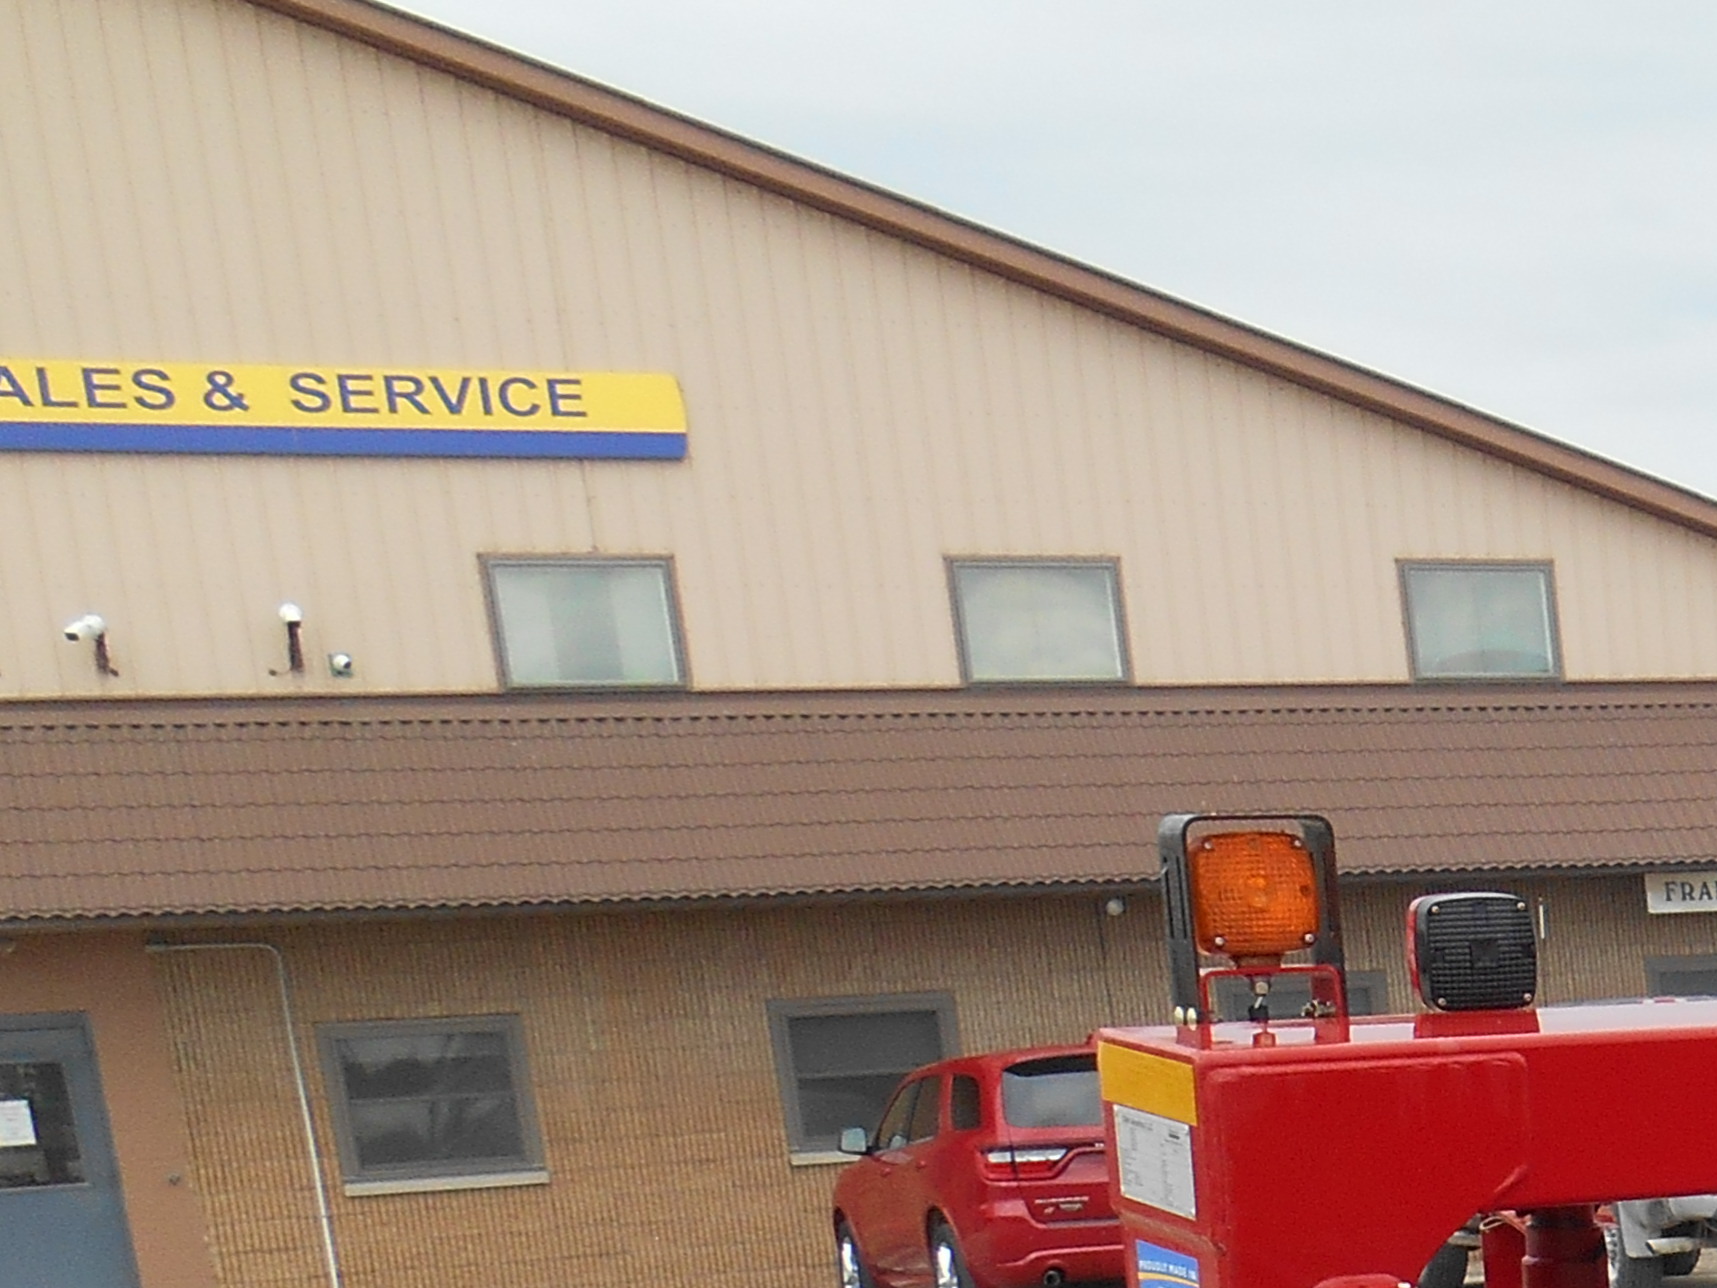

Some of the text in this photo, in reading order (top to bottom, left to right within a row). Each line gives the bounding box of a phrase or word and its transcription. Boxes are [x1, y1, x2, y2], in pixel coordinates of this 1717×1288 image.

[0, 366, 588, 417] ALES & SERVICE
